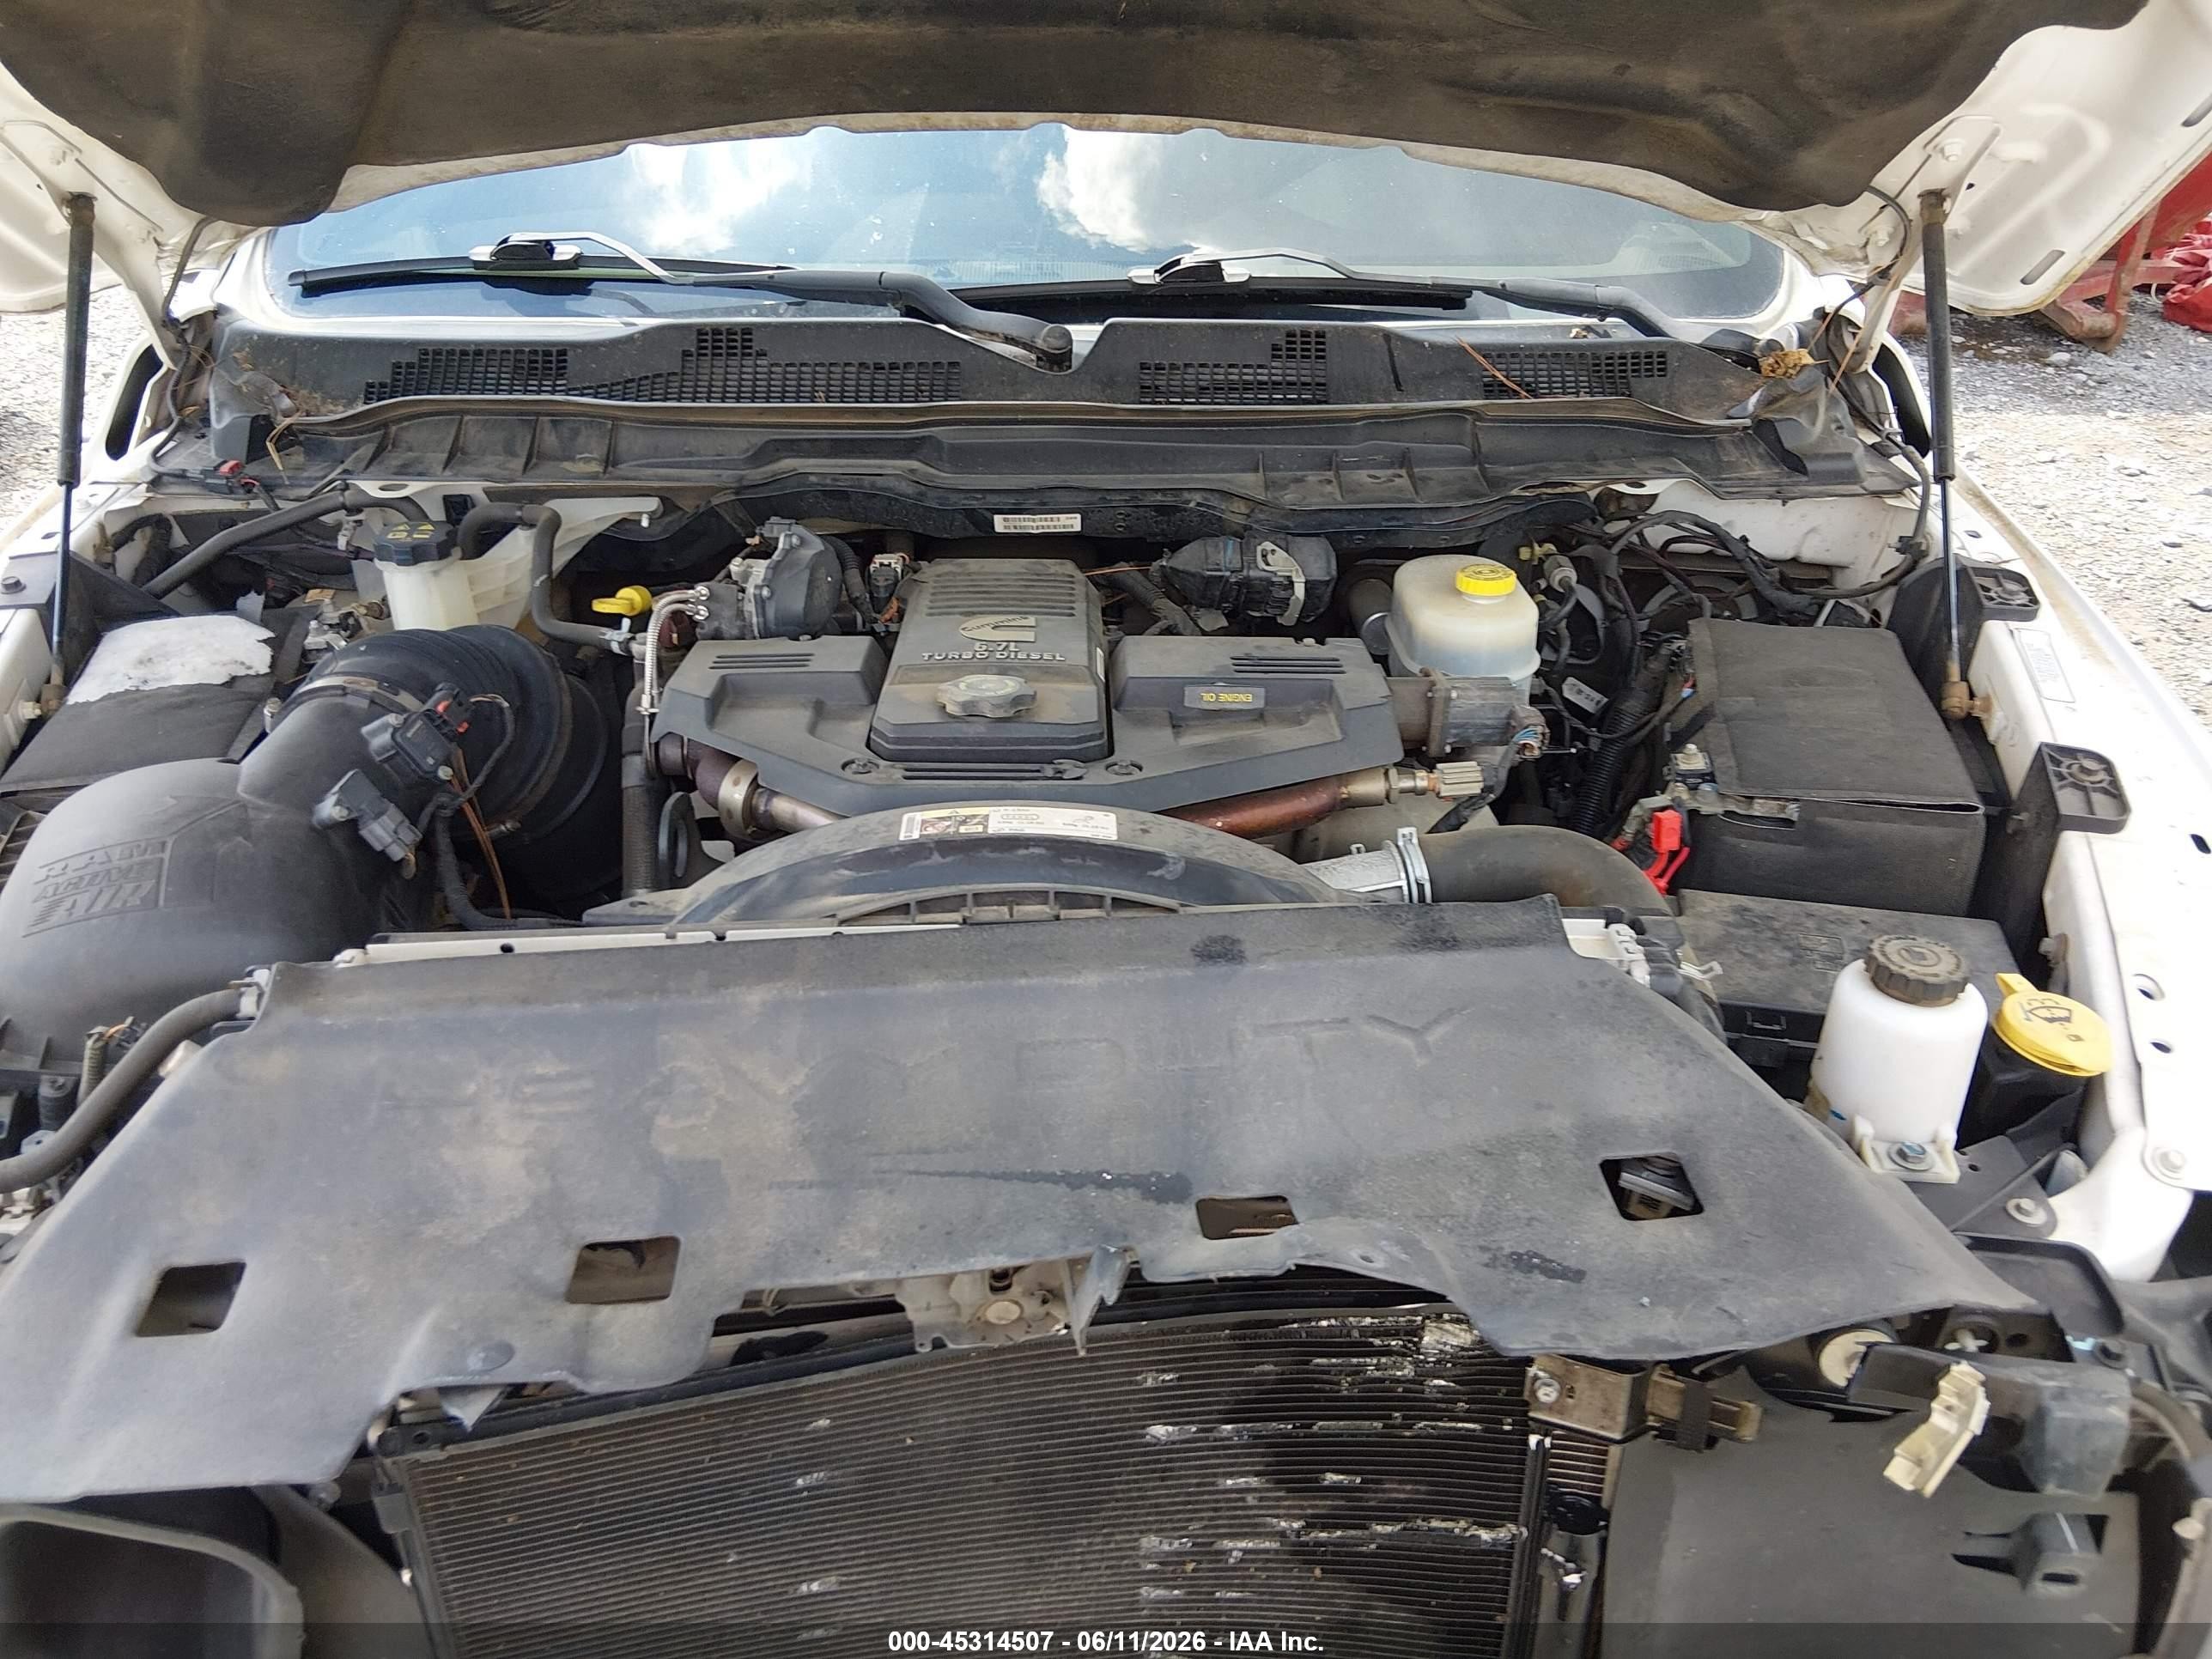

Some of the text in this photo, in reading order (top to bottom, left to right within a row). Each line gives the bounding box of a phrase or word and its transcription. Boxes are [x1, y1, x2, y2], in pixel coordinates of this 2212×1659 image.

[974, 642, 1021, 652] 6.7L
[921, 652, 1066, 660] TURBO DIESEL
[1200, 693, 1253, 702] ENGINE OIL
